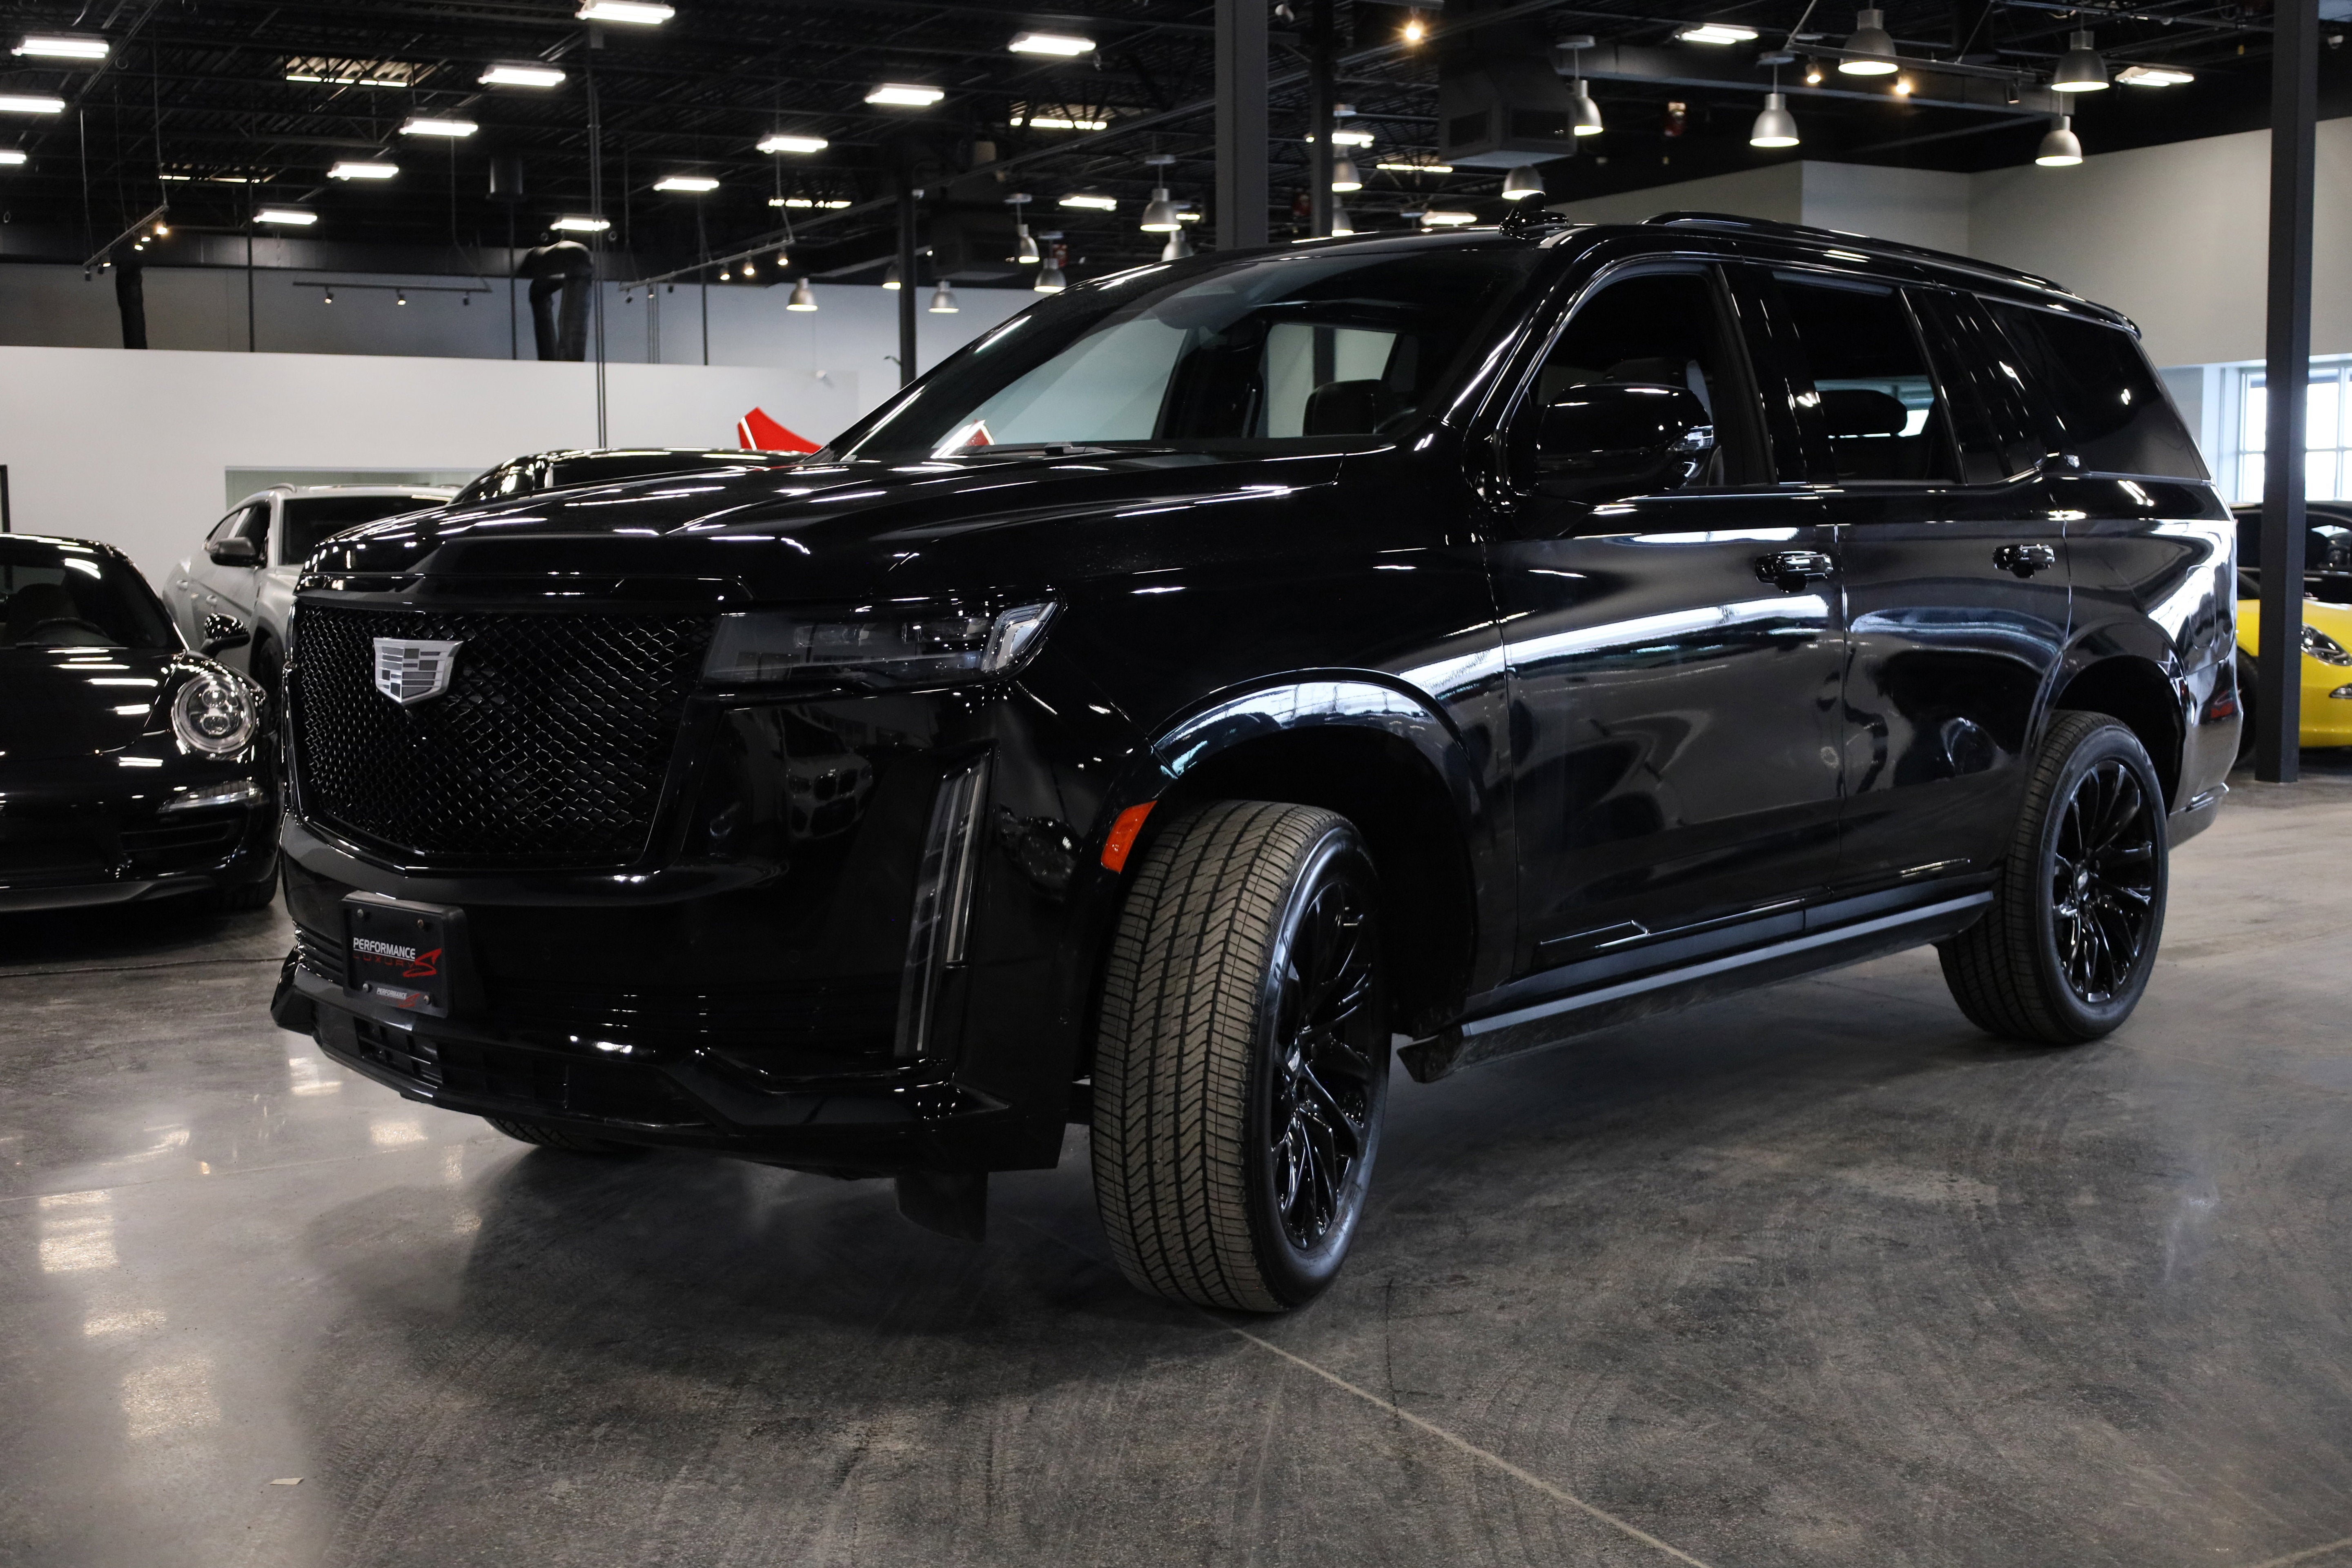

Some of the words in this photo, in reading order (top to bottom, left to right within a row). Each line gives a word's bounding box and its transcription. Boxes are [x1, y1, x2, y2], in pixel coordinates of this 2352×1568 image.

[353, 937, 416, 960] PERFORMANCE
[352, 952, 414, 968] LUXURY
[376, 987, 407, 1000] PERFORMANCE
